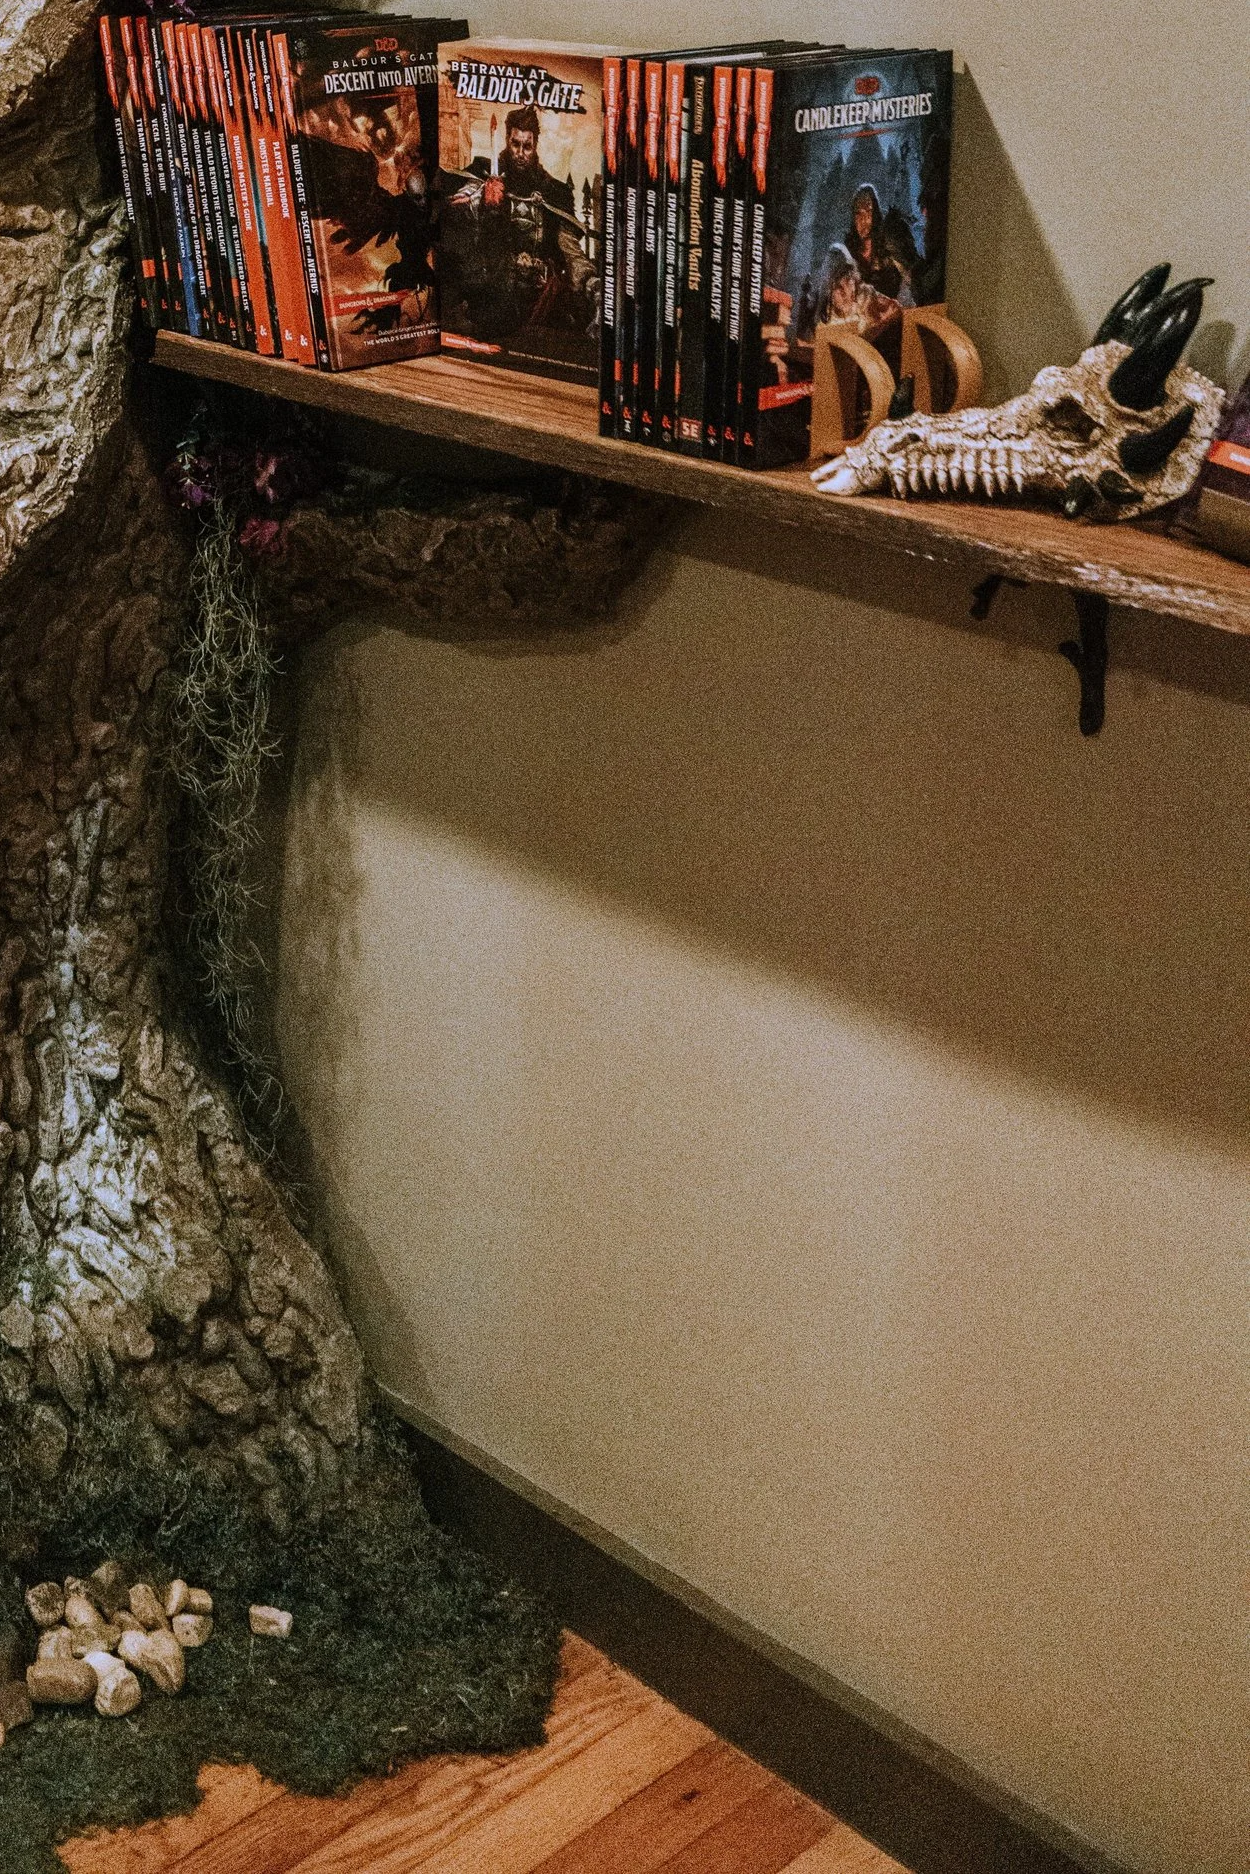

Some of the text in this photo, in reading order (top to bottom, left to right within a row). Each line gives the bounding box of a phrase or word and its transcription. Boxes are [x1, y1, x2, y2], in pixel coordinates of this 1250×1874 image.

[220, 37, 228, 69] DUNGEONS
[246, 39, 254, 72] DUNGEONS
[332, 52, 434, 69] BALDUR'S GAT
[260, 41, 268, 74] DUNGEONS
[266, 83, 274, 112] DRAGONS
[324, 64, 438, 94] DESCENT INTO AVERN
[451, 61, 547, 80] BETRAYAL AT
[456, 73, 583, 110] BALDUR'S GATE
[114, 117, 122, 136] KEYS
[795, 93, 932, 133] CANDLEKEEP MYSTERIES
[117, 137, 125, 154] FROM
[151, 118, 160, 143] VECNA
[136, 118, 152, 197] TYRANNY OF DRAGONS
[178, 123, 190, 177] DRAGONLANCE
[192, 128, 206, 193] MORDENKAINEN'S
[291, 144, 303, 182] BALDUR'S
[122, 169, 131, 197] GOLDEN
[157, 163, 163, 172] OF
[158, 172, 166, 192] RUIN
[209, 166, 218, 195] BEYOND
[233, 135, 252, 231] DUNGEON MASTER'S GUIDE
[258, 138, 274, 207] MONSTER MANUAL
[272, 141, 290, 218] PLAYER'S HANDBOOK
[186, 183, 195, 217] SHADOW
[201, 194, 210, 215] TOME
[212, 195, 220, 210] THE
[296, 182, 305, 203] GATE
[646, 189, 656, 207] OUT
[126, 198, 135, 222] VAULT
[191, 217, 196, 225] OF
[218, 133, 231, 179] PHANDELVER
[227, 192, 235, 218] BELOW
[233, 238, 244, 281] SHATTERED
[240, 281, 249, 312] OBELISK
[647, 207, 654, 215] OF
[667, 192, 677, 239] EXPLORER'S
[688, 158, 704, 291] Abomination Vaults
[732, 198, 744, 252] XANATHAR'S
[204, 221, 213, 243] FOES
[215, 211, 227, 258] WITCHLIGHT
[300, 210, 312, 244] DESCENT
[625, 186, 636, 296] ACQUISITIONS INCORPORATED
[645, 227, 655, 253] ABYSS
[194, 239, 203, 271] DRAGON
[604, 183, 615, 326] VAN RICHTEN'S GUIDE TO RAVENLOFT
[666, 239, 676, 265] GUIDE
[711, 197, 725, 320] PRINCES OF THE APOCALYPSE
[731, 252, 742, 279] GUIDE
[750, 203, 764, 315] CANDLEKEEP MYSTERIES
[198, 271, 206, 297] QUEEN
[307, 257, 318, 294] AVERNUS
[338, 299, 366, 310] DUNGEONS
[664, 273, 675, 327] WILDEMOUNT
[730, 287, 741, 341] EVERYTHING
[375, 335, 399, 344] WORLD'S
[399, 331, 427, 340] GREATEST
[682, 421, 699, 438] 5E
